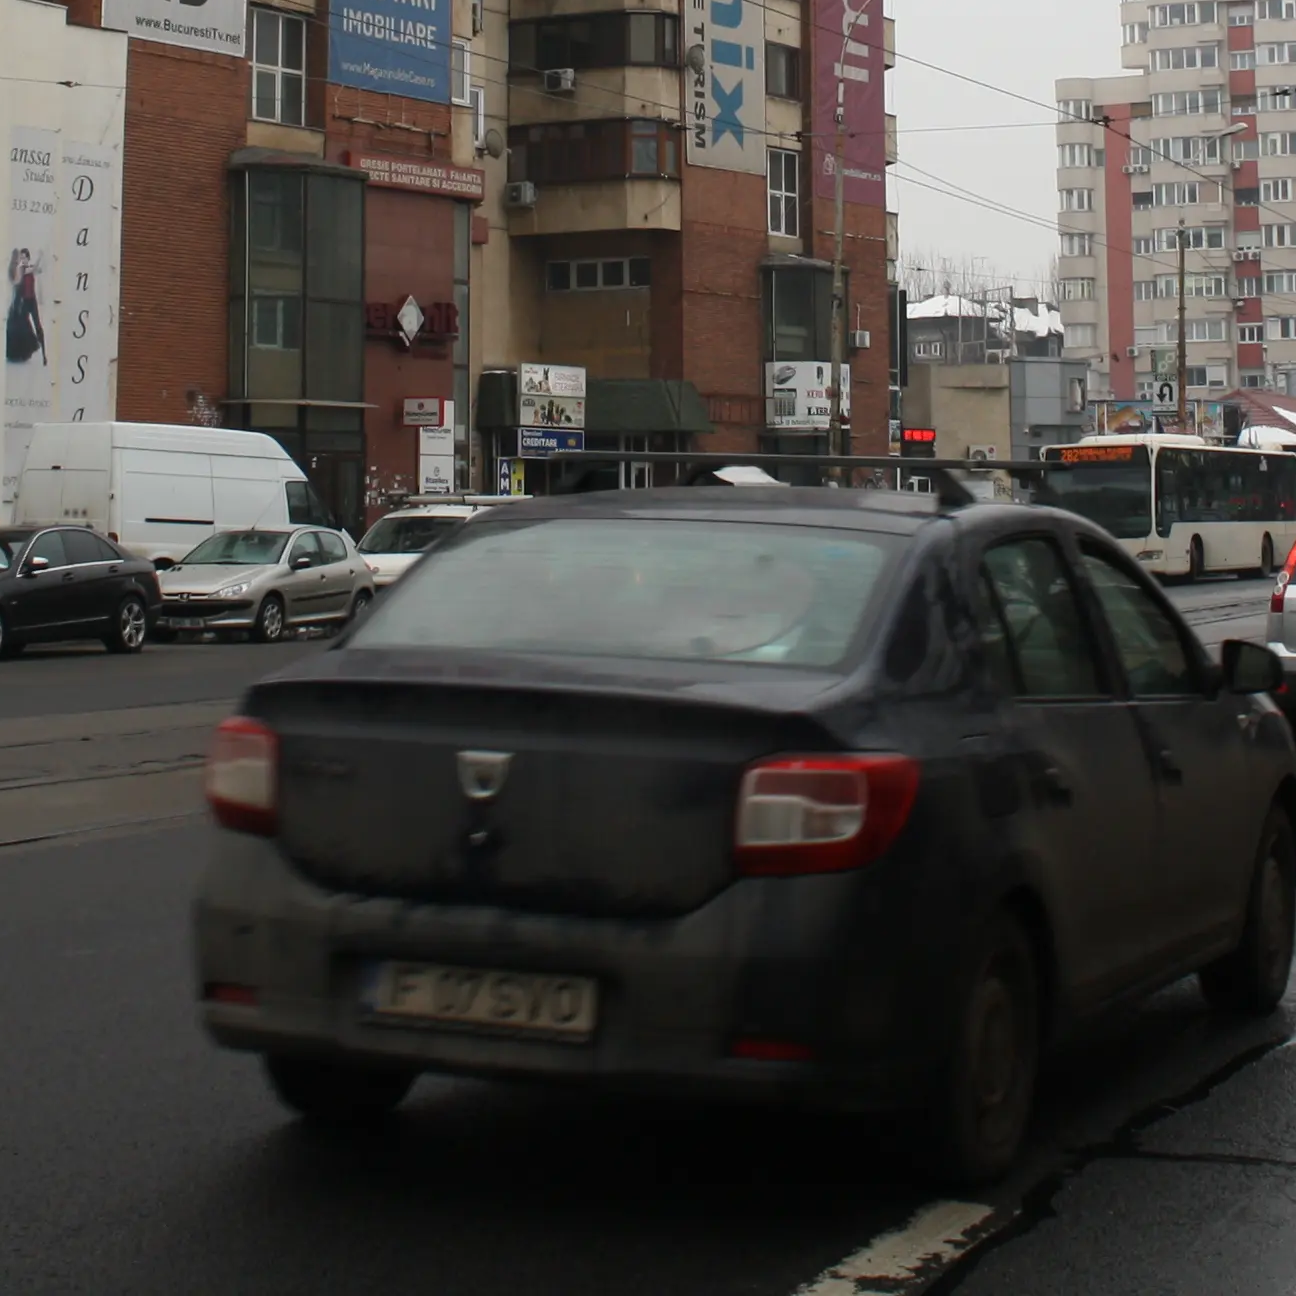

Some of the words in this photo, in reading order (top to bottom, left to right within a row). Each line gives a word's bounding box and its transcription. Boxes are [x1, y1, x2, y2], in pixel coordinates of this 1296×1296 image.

[135, 14, 242, 46] www.BucurestiTv.net
[342, 7, 438, 52] IMOBILIARE
[693, 22, 707, 149] TRISM
[360, 157, 390, 172] GRESIE
